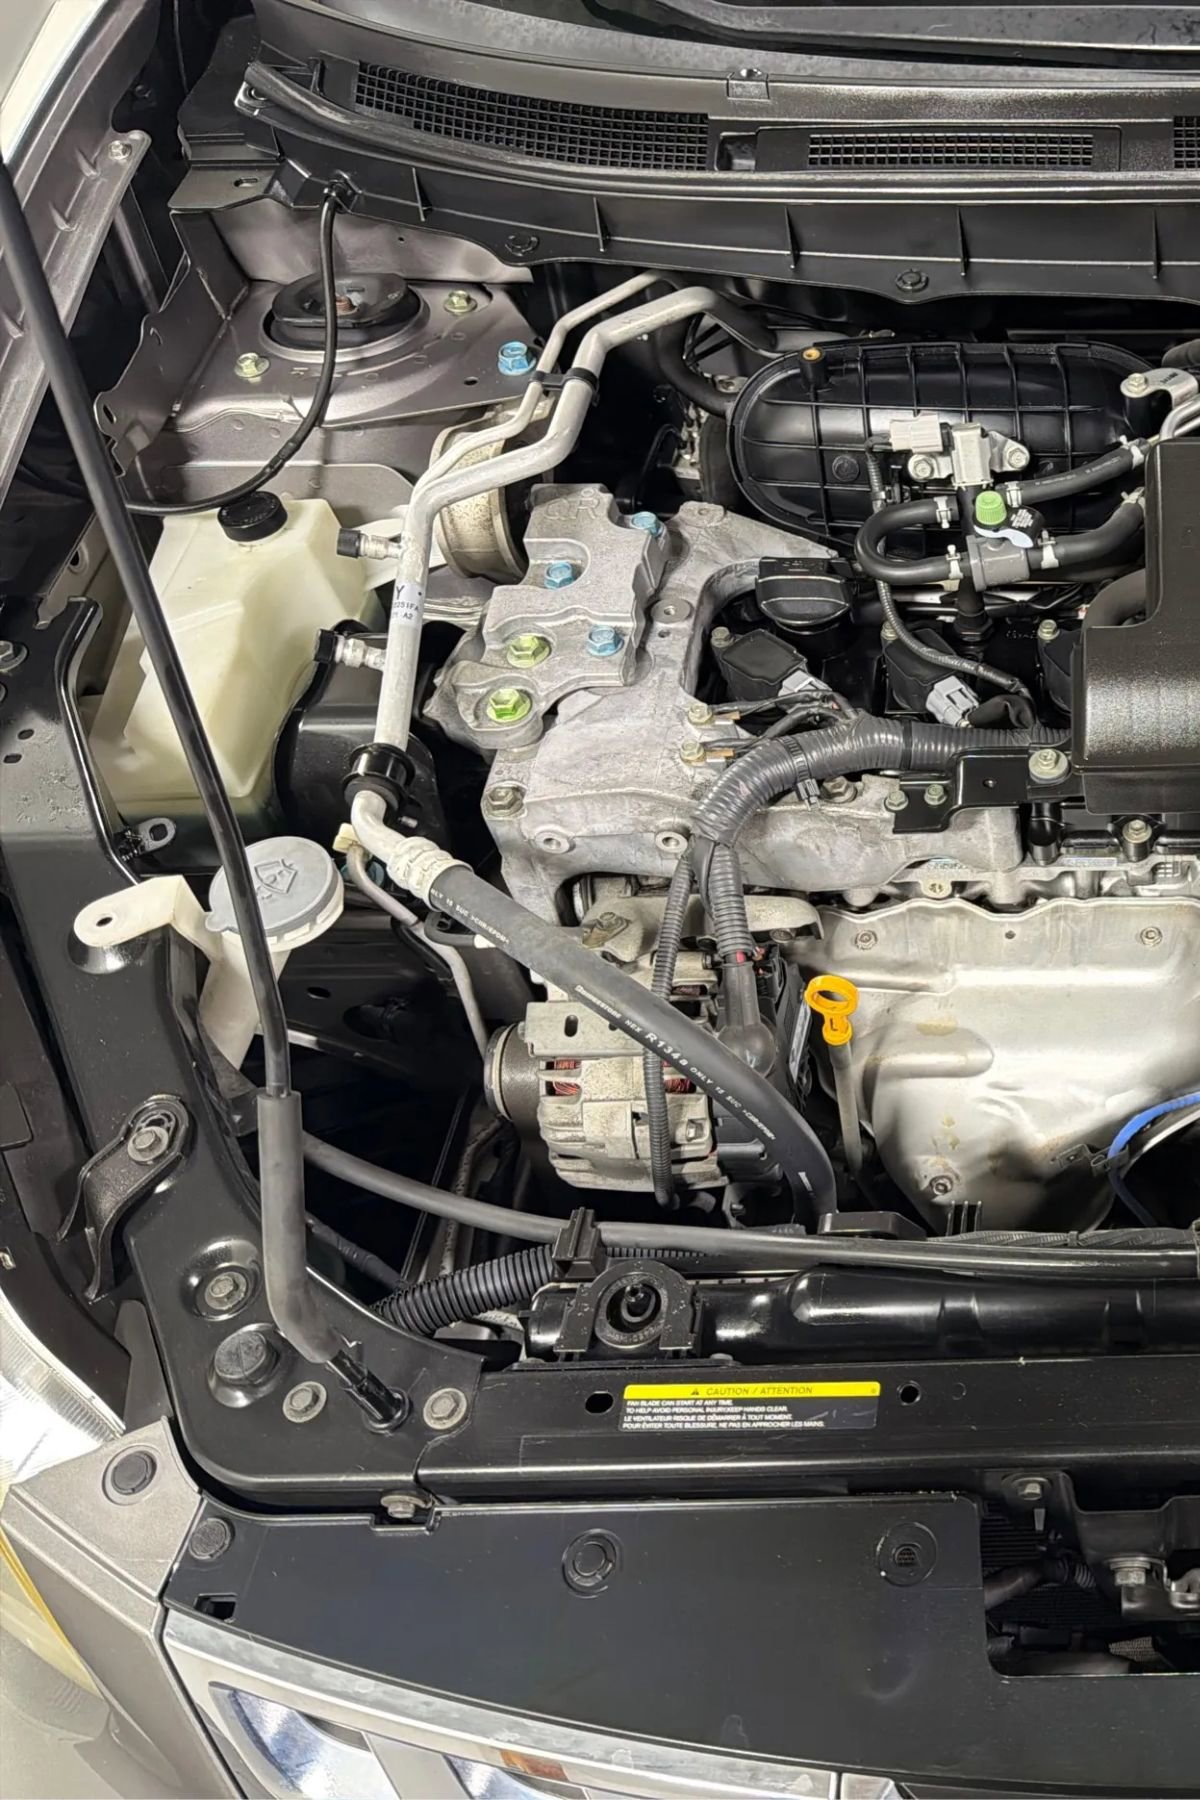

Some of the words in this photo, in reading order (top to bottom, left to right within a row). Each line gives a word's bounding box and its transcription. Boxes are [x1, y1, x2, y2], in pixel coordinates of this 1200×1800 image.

[829, 1018, 839, 1031] L
[624, 1019, 643, 1033] NEX
[645, 1033, 688, 1066] R134a
[690, 1067, 714, 1084] ONLY
[706, 1387, 749, 1396] CAUTION
[760, 1386, 813, 1395] ATTENTION
[673, 1414, 696, 1422] RISQUE
[697, 1414, 706, 1422] DE
[707, 1413, 741, 1421] DÉMARRER
[641, 1421, 663, 1429] ÉVITER
